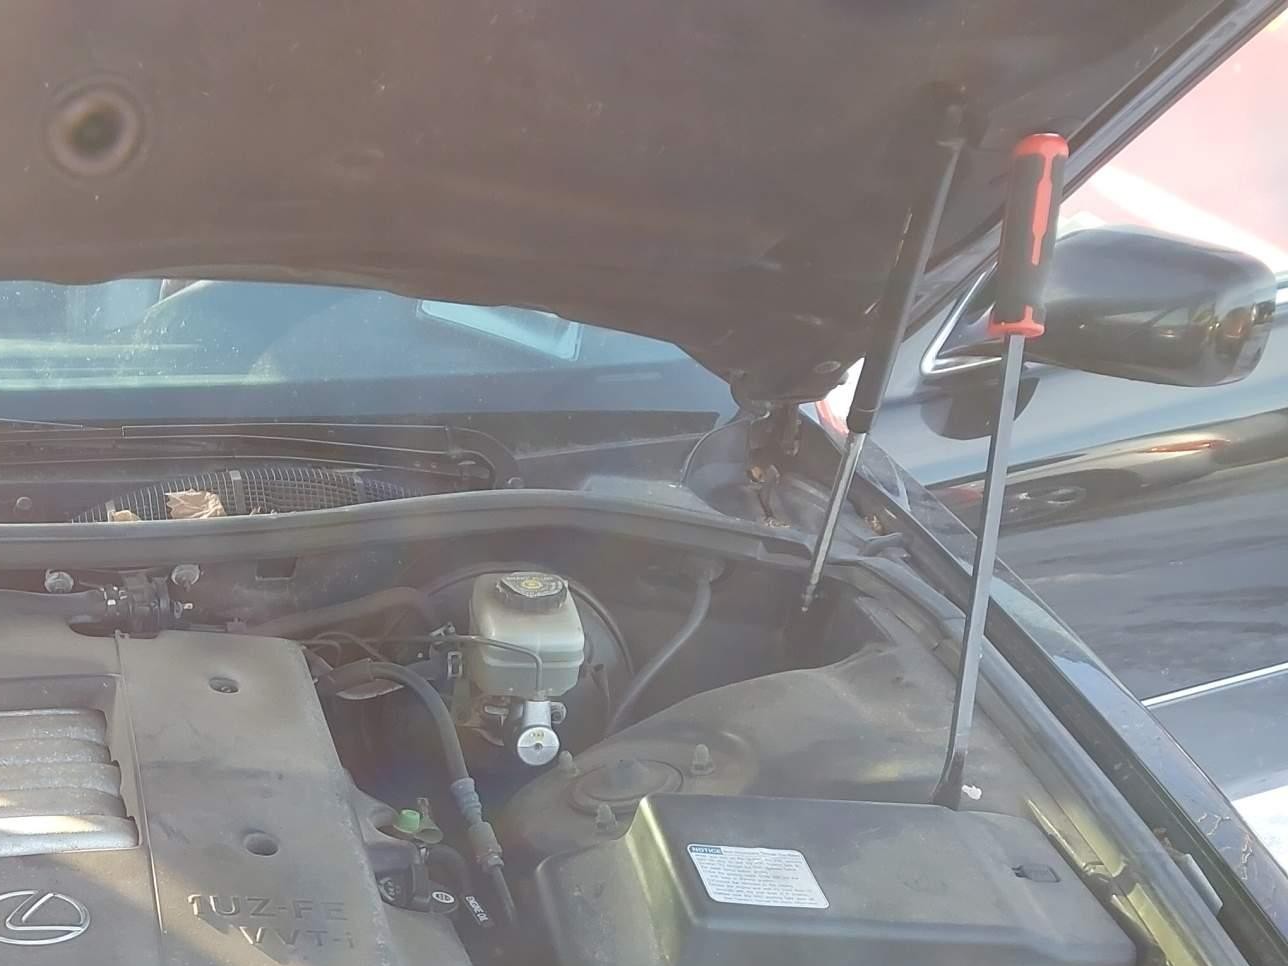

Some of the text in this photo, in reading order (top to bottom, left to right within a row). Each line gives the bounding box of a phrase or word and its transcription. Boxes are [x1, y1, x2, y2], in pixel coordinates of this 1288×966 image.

[692, 846, 722, 855] NOTICE
[187, 894, 348, 921] 1UZ-FE
[239, 926, 356, 950] VVT-i
